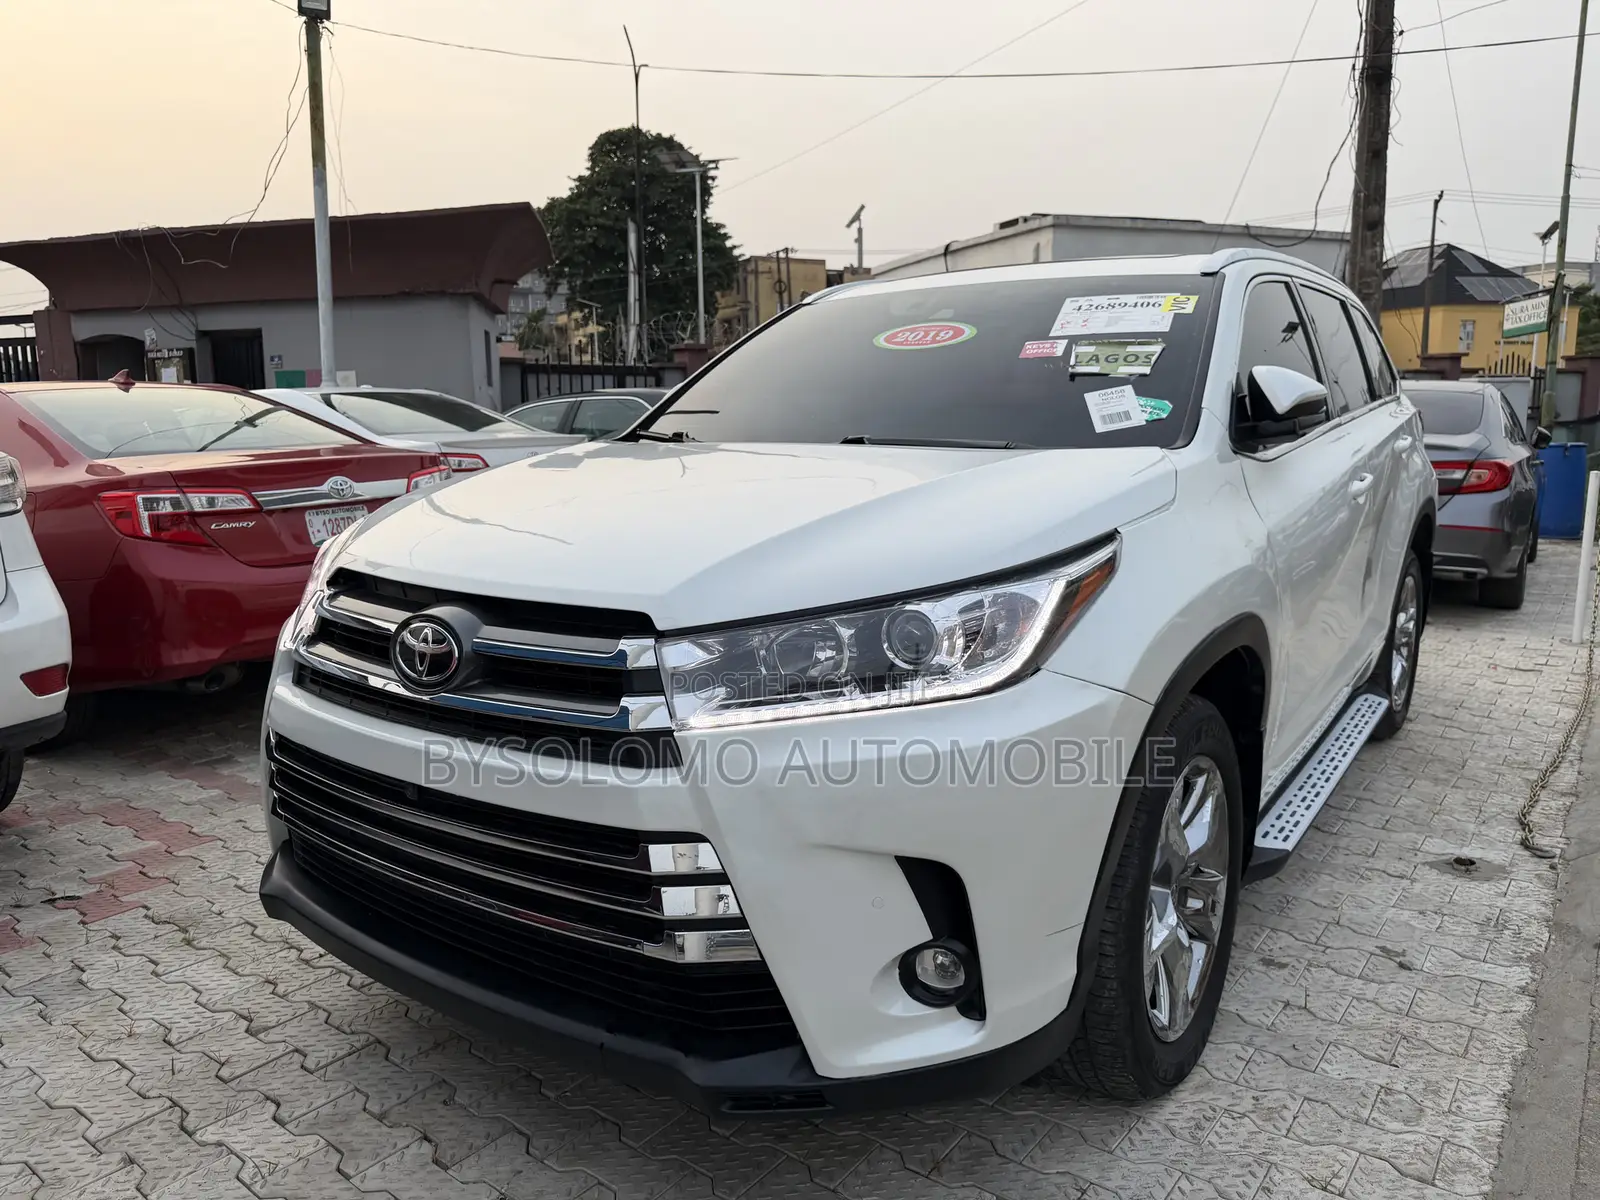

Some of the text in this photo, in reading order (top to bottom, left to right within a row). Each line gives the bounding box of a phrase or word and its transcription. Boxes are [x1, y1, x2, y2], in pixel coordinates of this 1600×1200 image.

[1072, 300, 1163, 312] 42689406
[892, 329, 954, 342] 2019
[1074, 353, 1157, 365] LAGOS
[210, 521, 256, 530] CAMRY
